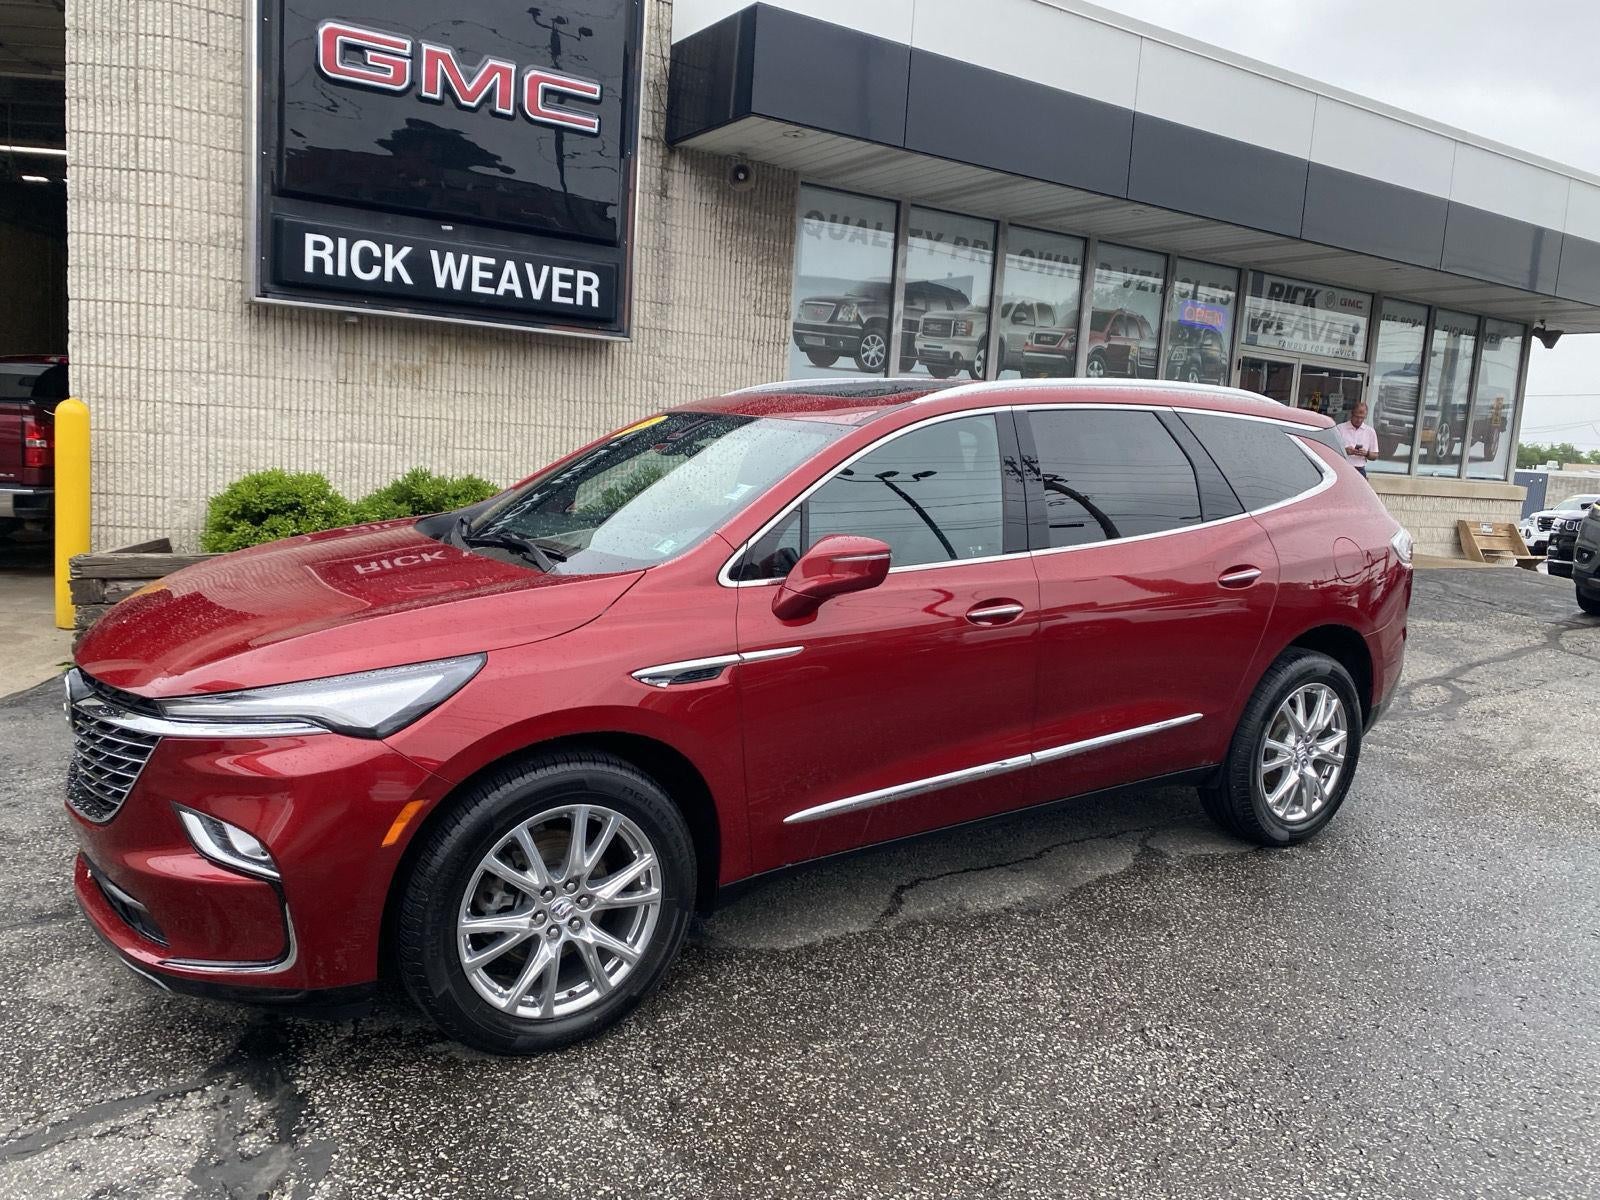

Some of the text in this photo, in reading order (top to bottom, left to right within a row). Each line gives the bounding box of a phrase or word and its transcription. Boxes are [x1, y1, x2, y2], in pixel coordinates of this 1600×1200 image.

[317, 21, 602, 133] GMC
[303, 233, 600, 308] RICK WEAVER
[803, 210, 945, 257] QUALTY
[1018, 248, 1113, 286] OWND
[1122, 266, 1232, 306] VEHCLES
[1184, 305, 1223, 326] OPEN
[1263, 281, 1322, 315] RICK
[1340, 298, 1363, 310] GMC
